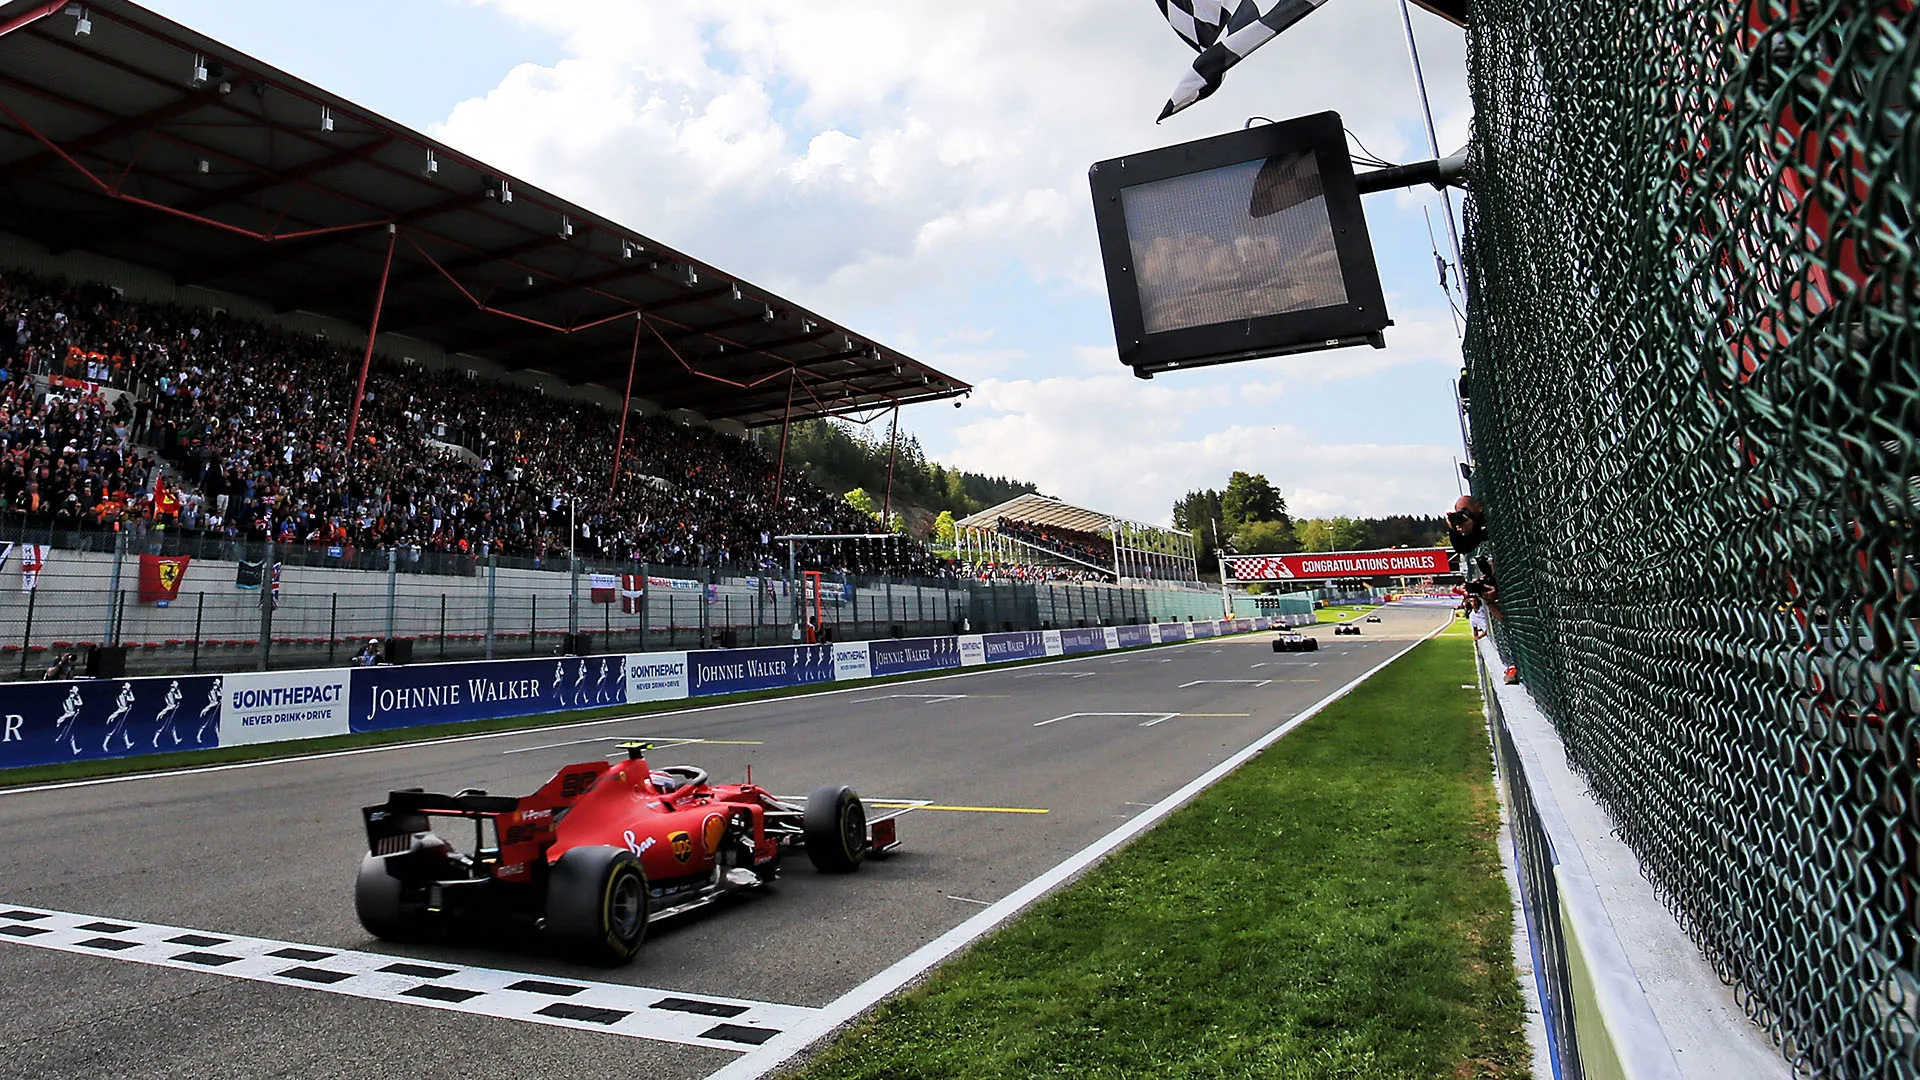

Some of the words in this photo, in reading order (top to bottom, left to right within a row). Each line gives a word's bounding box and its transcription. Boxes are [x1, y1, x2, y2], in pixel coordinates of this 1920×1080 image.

[1302, 558, 1389, 573] CONGRATULATIONS
[1390, 556, 1435, 570] CHARLES
[905, 648, 931, 662] WALKER
[697, 663, 744, 688] JOHNNIE
[747, 660, 787, 677] WALKER
[233, 684, 342, 709] #JOINTHEPACT
[367, 685, 460, 720] JOHNNIE
[468, 678, 540, 703] WALKER
[242, 715, 272, 726] NEVER
